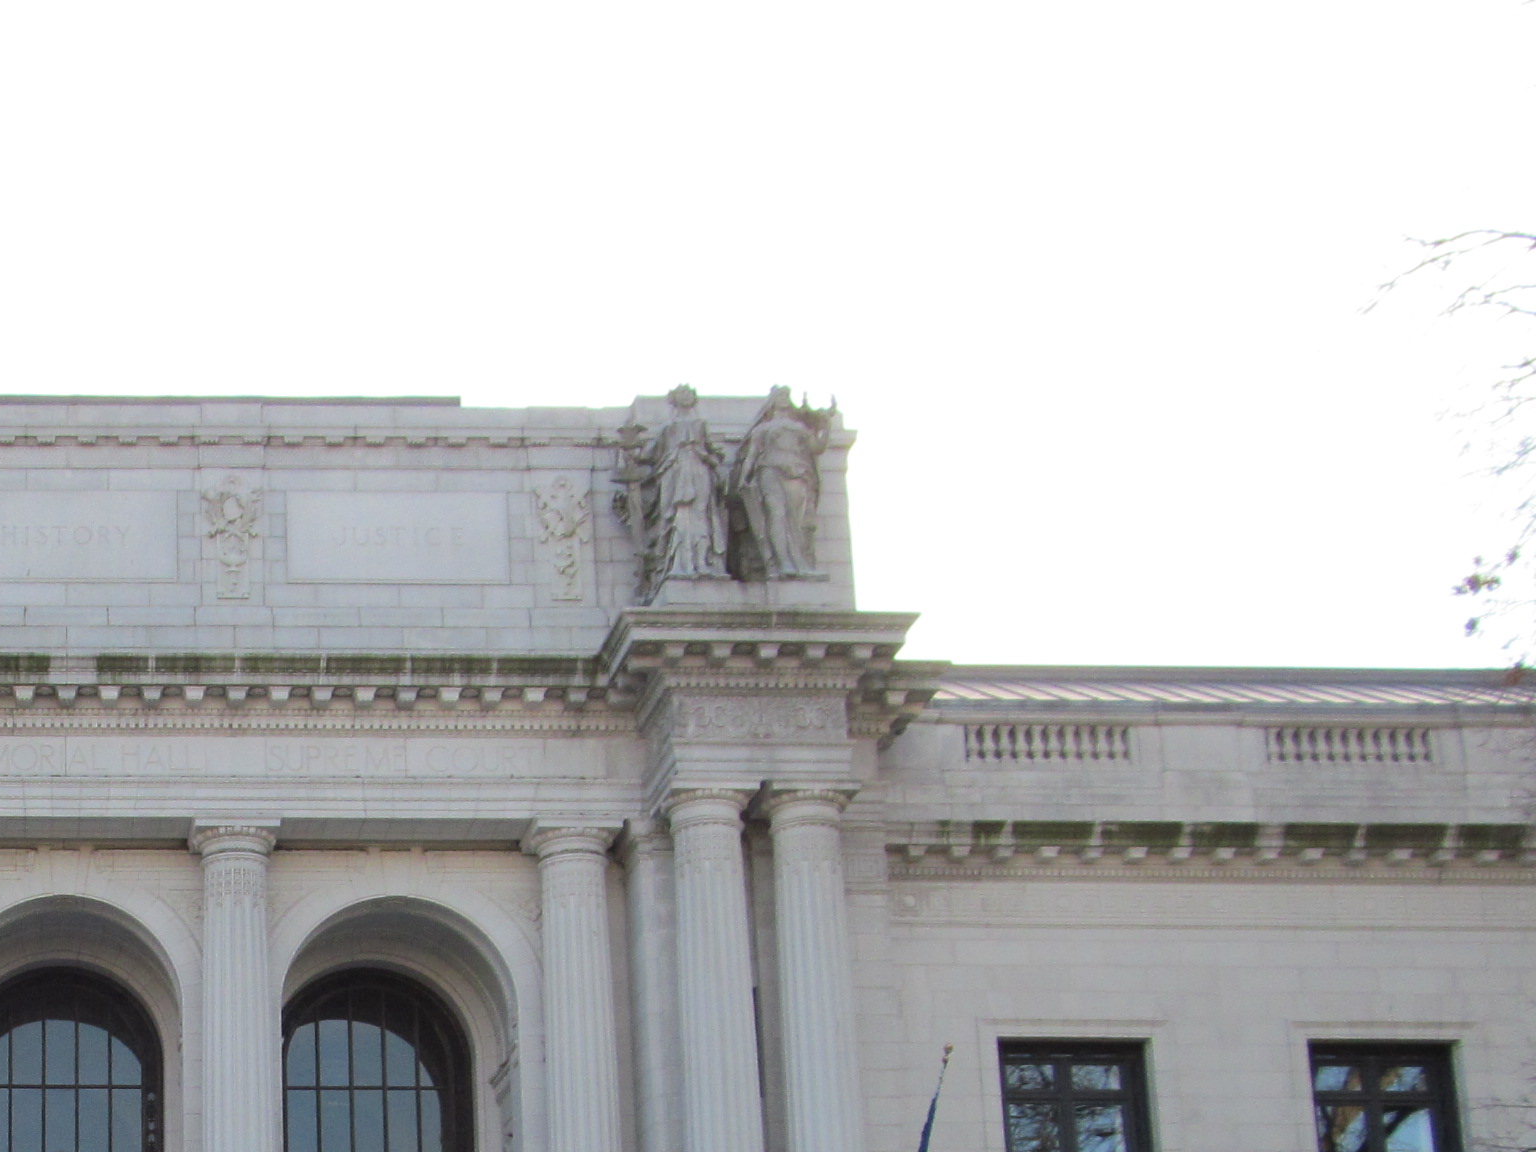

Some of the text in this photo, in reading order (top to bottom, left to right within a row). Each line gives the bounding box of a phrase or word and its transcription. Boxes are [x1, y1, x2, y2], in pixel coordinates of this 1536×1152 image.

[0, 525, 131, 546] HISTORY
[334, 526, 465, 547] JUSTICE
[120, 744, 202, 770] HALL
[267, 744, 538, 772] SUPREME COURT
